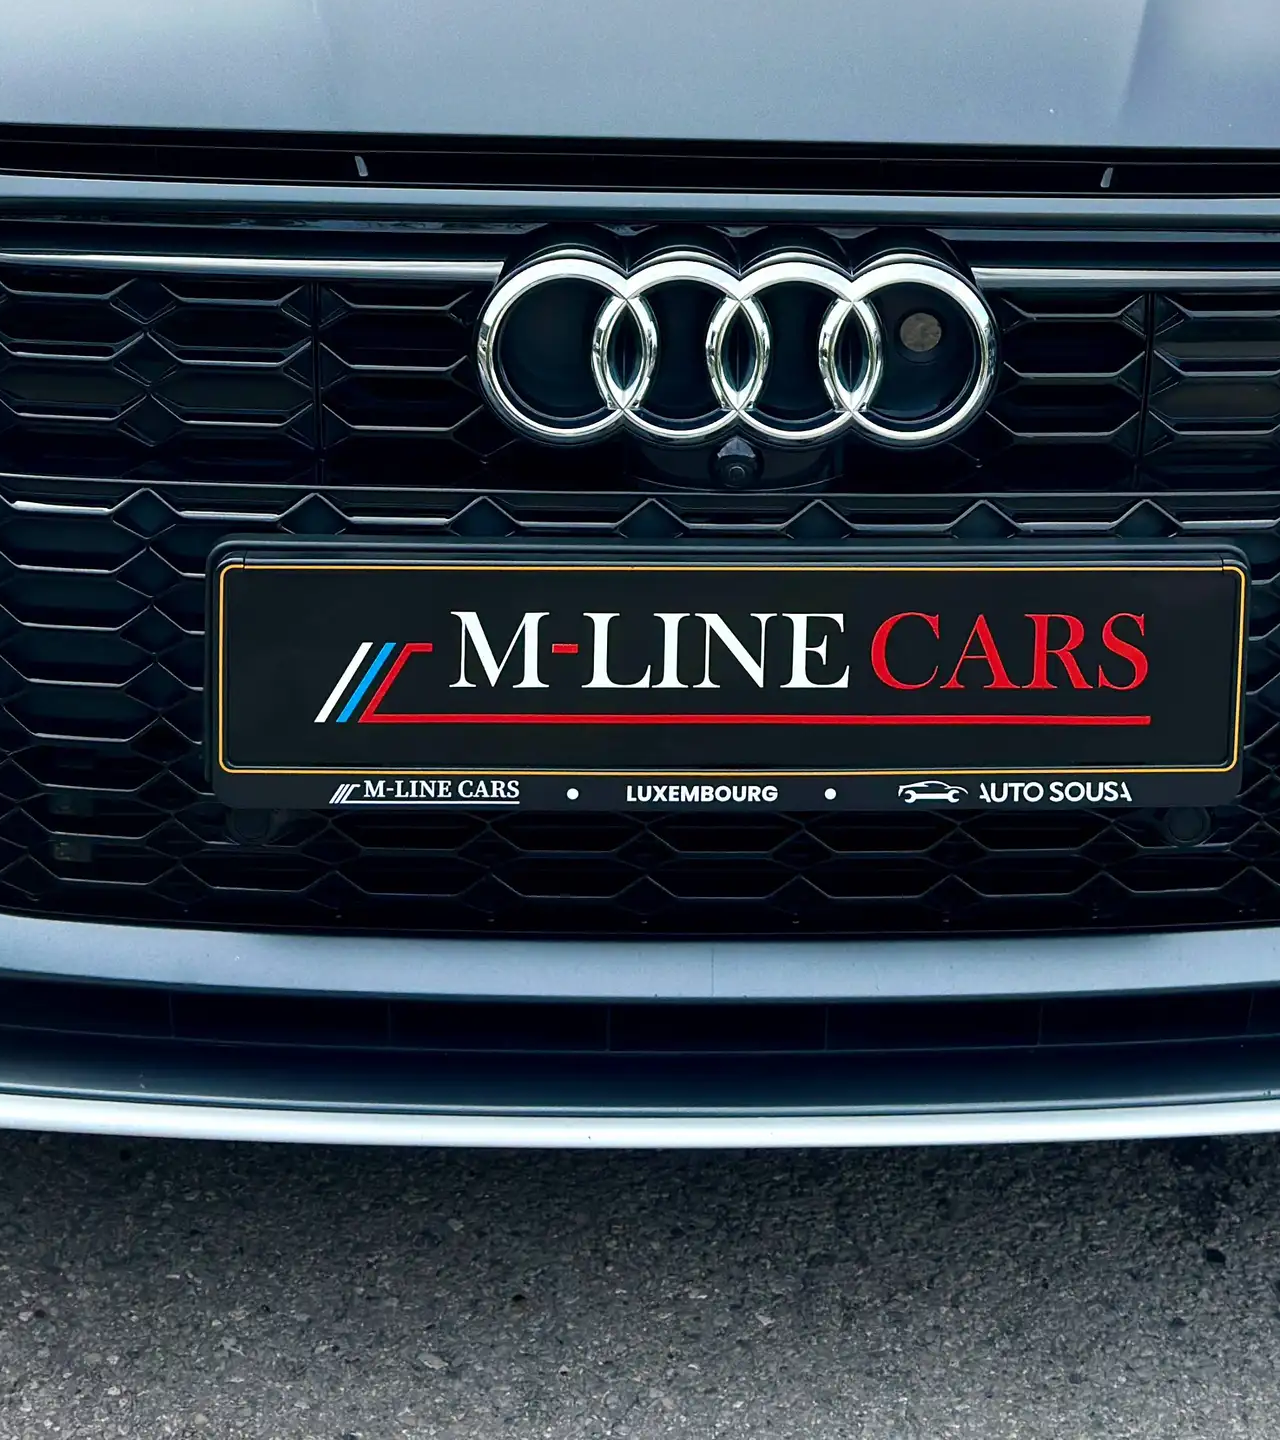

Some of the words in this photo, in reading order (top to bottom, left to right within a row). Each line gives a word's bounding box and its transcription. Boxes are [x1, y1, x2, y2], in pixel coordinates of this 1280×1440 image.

[449, 610, 849, 689] M-LINE
[869, 610, 1150, 691] CARS
[363, 780, 452, 799] M-LINE
[457, 779, 520, 800] CARS
[626, 785, 779, 803] LUXEMBOURG
[979, 782, 1043, 803] AUTO
[1049, 781, 1132, 803] SOUSA
